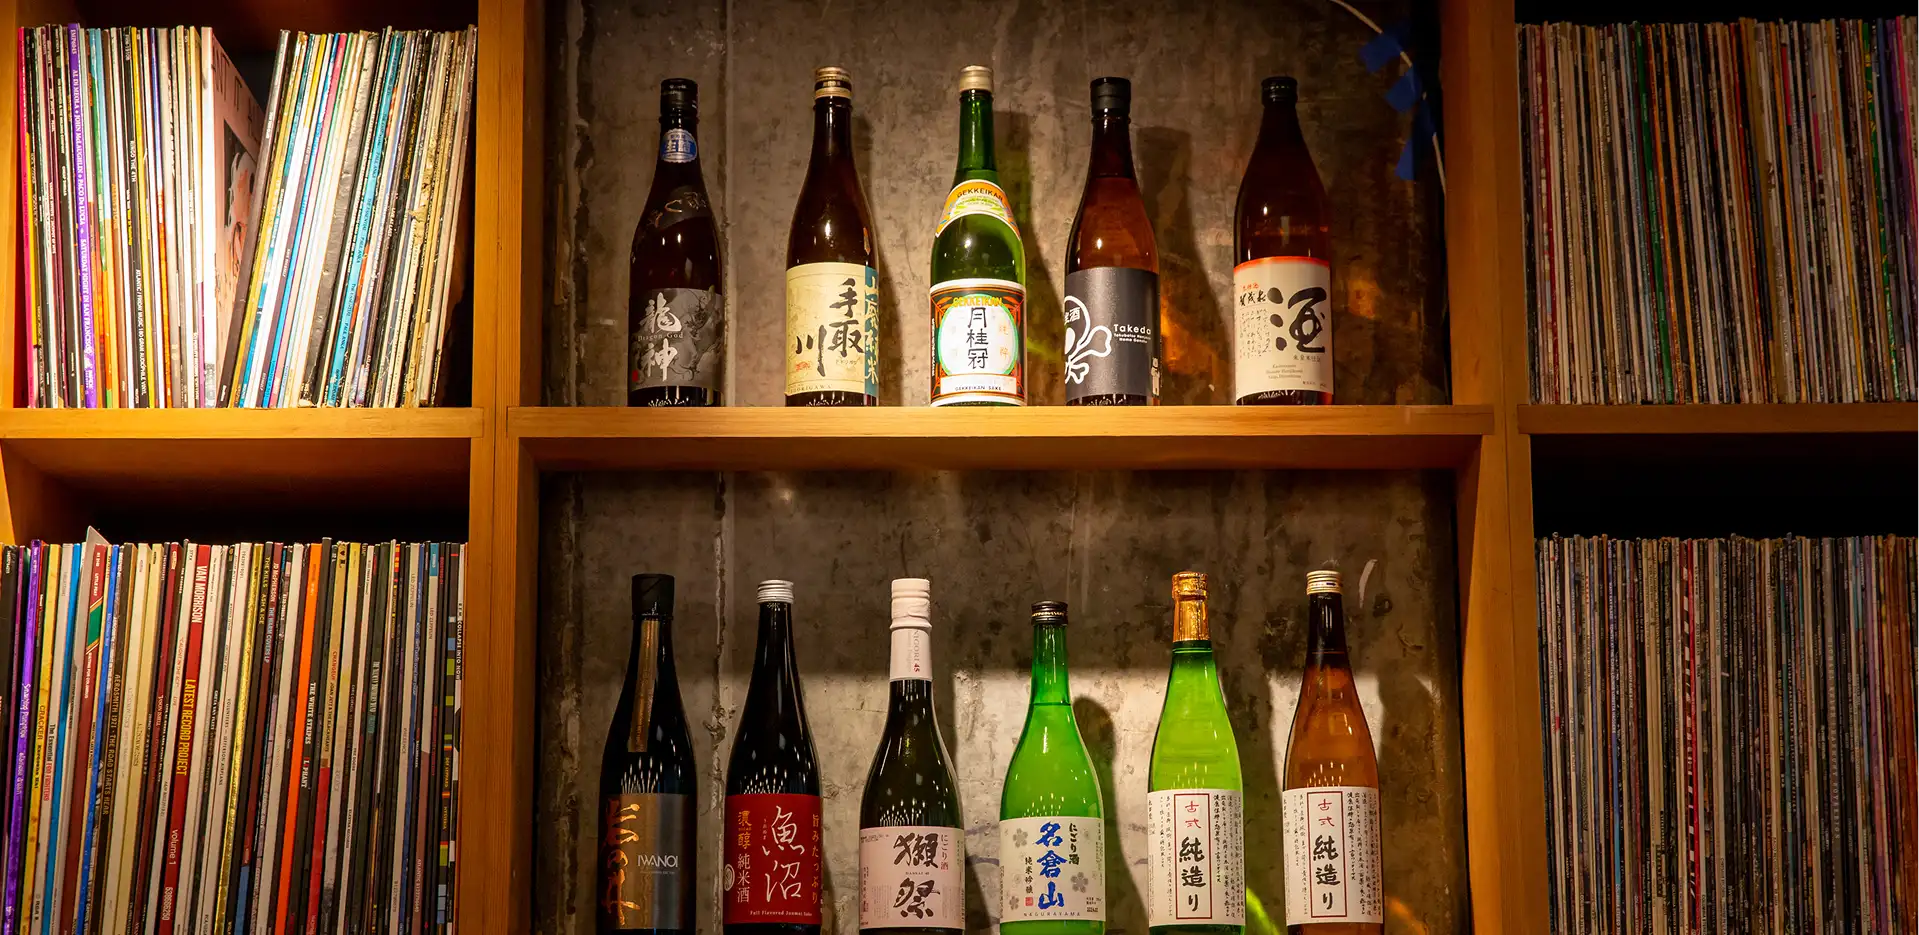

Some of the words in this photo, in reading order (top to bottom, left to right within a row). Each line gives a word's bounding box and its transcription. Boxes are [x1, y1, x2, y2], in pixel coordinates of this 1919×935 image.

[73, 85, 81, 108] MEOLA
[74, 115, 82, 131] JOHN
[75, 133, 83, 173] McLAUGHLIN
[957, 188, 1003, 201] GEKKEIKAN
[78, 207, 86, 225] LUCIA
[81, 239, 89, 271] SATURDAY
[82, 273, 90, 294] NIGHT
[953, 296, 1003, 308] GEKKEIKAN
[828, 278, 864, 357] 手取
[1114, 324, 1152, 335] Takeda
[1267, 287, 1327, 353] 酒
[667, 332, 683, 340] God
[966, 307, 988, 370] 月桂冠
[796, 325, 827, 377] 川
[196, 566, 207, 580] VAN
[270, 570, 278, 602] McPHERSON
[191, 583, 206, 623] MORRISON
[265, 635, 273, 655] COVERS
[914, 663, 920, 672] 45
[111, 674, 120, 712] AEROSMITH
[183, 679, 196, 708] LATEST
[37, 705, 46, 740] CRACKER
[48, 724, 56, 734] The
[180, 710, 192, 740] RECORD
[305, 719, 313, 744] STRIPES
[46, 736, 55, 761] Essential
[176, 742, 190, 776] PROJECT
[44, 775, 52, 801] FIGHTERS
[105, 770, 113, 794] STARTS
[103, 797, 111, 815] HEAR
[1185, 801, 1201, 829] 古式
[1318, 799, 1335, 827] 古式
[170, 829, 179, 858] volume
[762, 805, 805, 903] 魚沼
[1068, 823, 1080, 865] にごり酒
[638, 855, 678, 868] IWANOI
[812, 814, 820, 904] 旨みたっぷり
[1035, 822, 1068, 910] 名倉山
[1313, 835, 1340, 910] 純造り
[737, 853, 750, 904] 純米酒
[1179, 836, 1206, 912] 純造り
